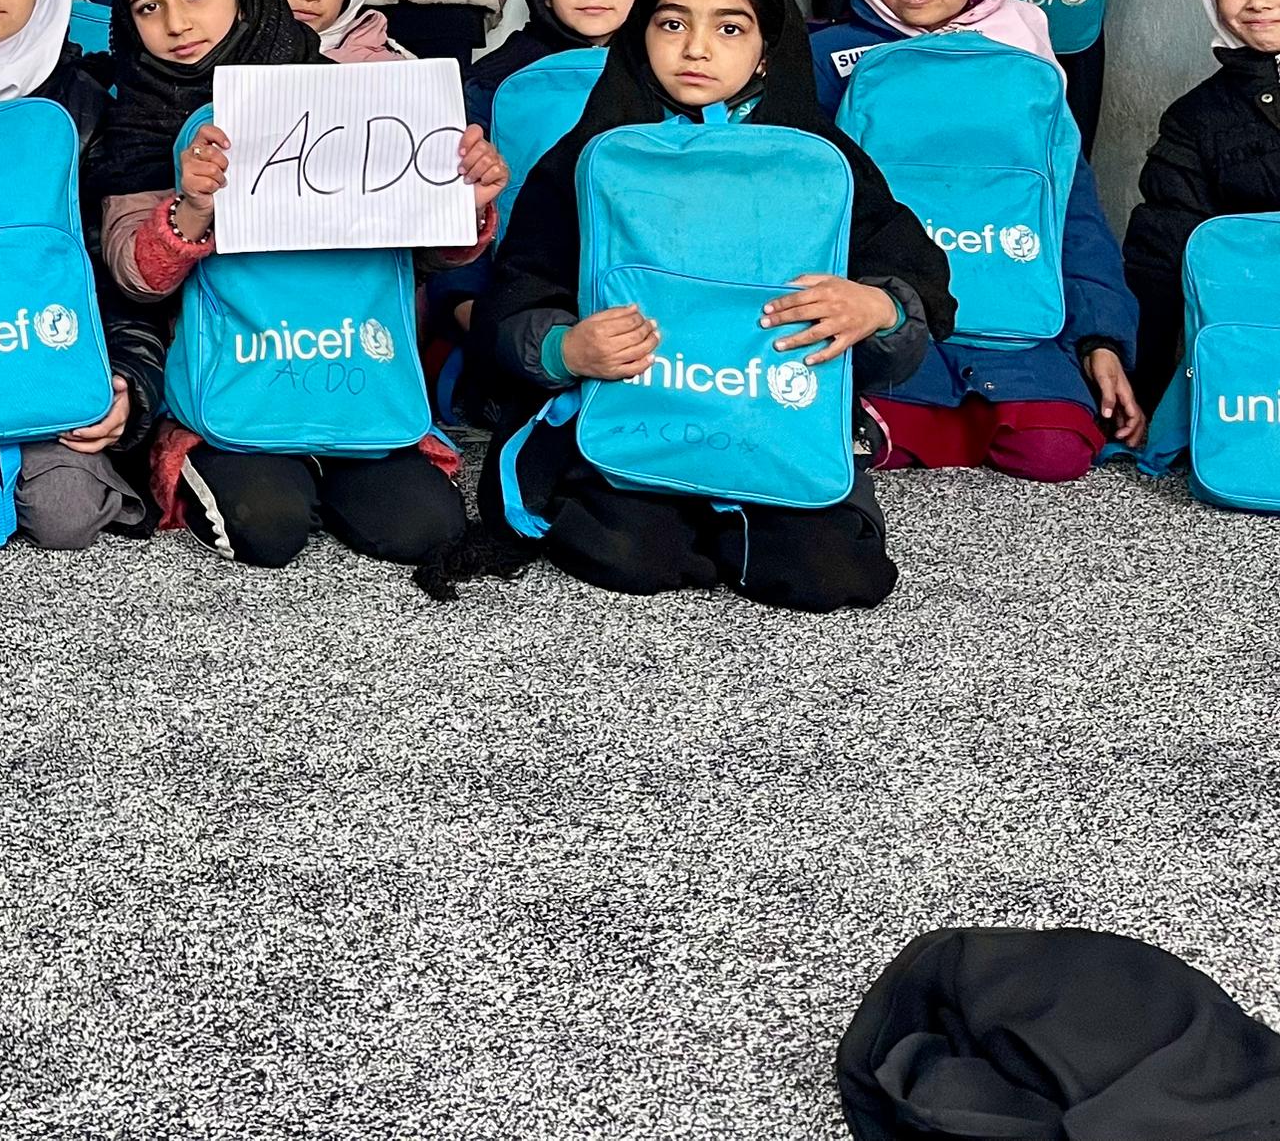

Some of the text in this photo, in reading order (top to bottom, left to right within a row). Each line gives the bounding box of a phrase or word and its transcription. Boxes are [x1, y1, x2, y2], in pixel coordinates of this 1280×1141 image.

[250, 110, 467, 198] ACDO
[235, 317, 356, 363] unicef
[269, 360, 366, 396] ACDO
